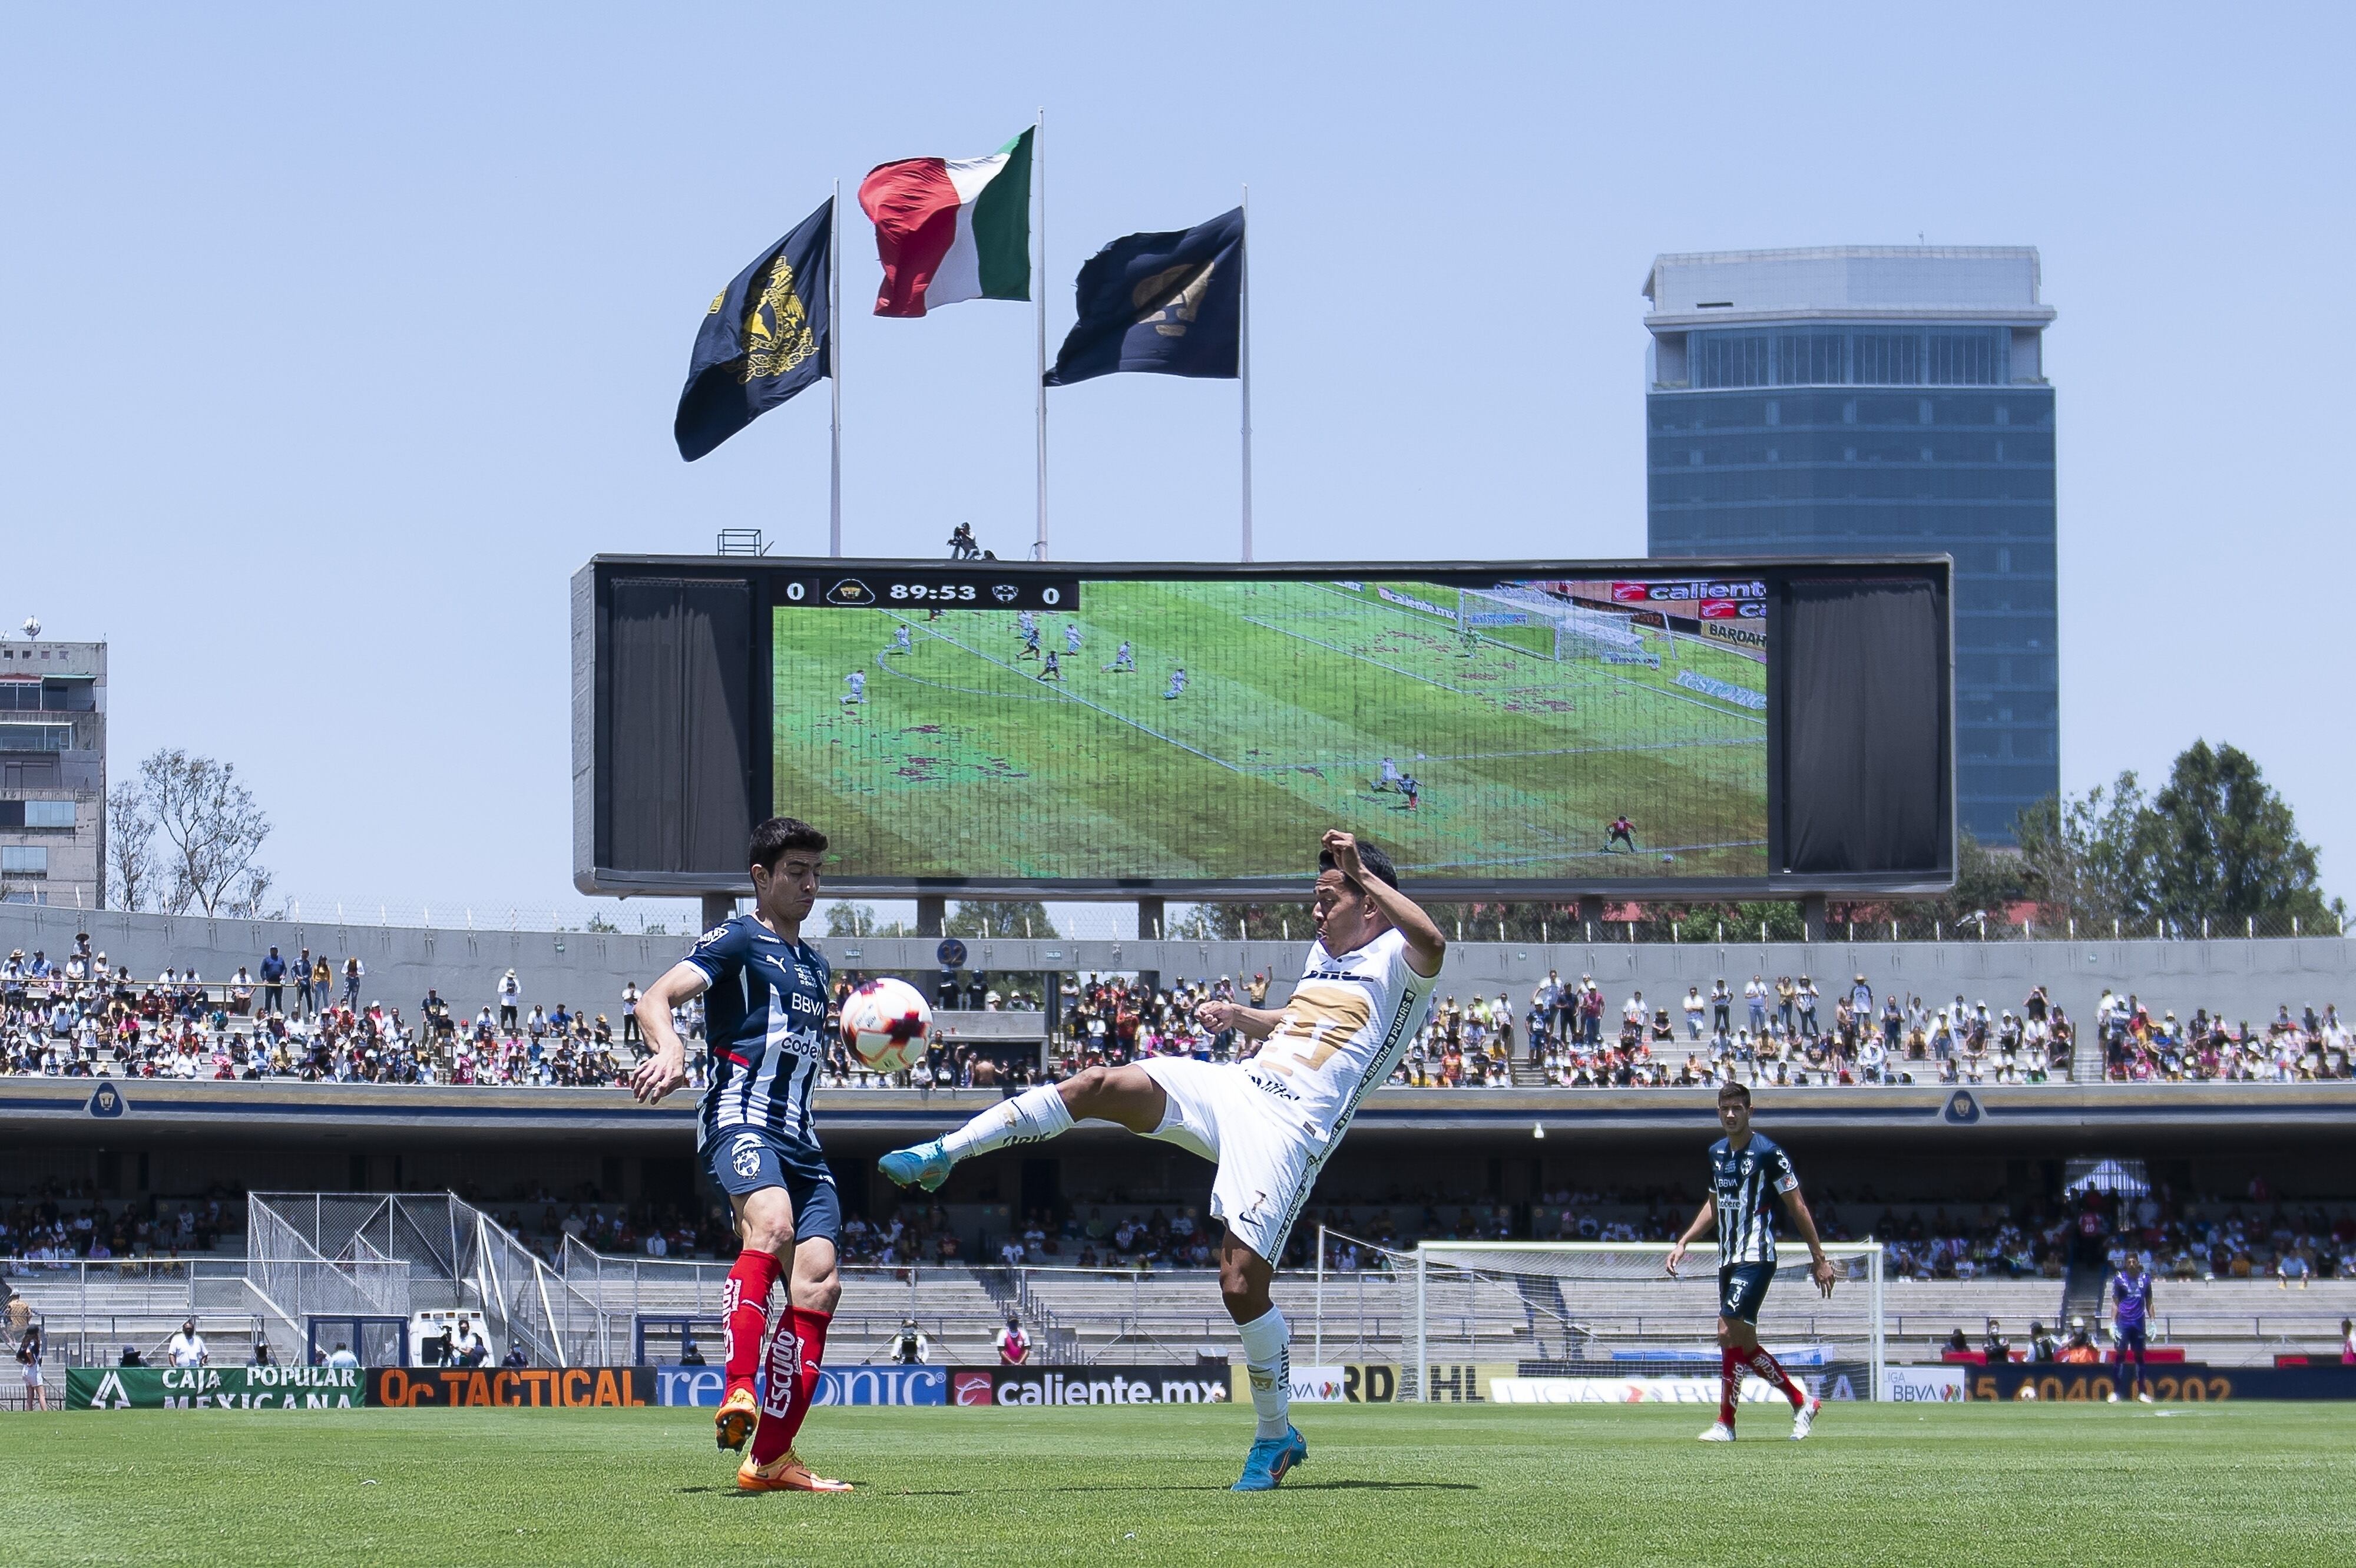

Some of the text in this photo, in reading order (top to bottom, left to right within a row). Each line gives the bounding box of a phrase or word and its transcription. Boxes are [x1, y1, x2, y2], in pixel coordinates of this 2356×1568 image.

[787, 583, 805, 600] 0
[890, 584, 977, 600] 89:53
[1042, 588, 1060, 604] 0
[1650, 581, 1766, 600] calient
[942, 945, 963, 964] 32
[1391, 1001, 1411, 1037] PUMAS
[1366, 1044, 1391, 1079] PUMAS
[1718, 1179, 1738, 1187] BBVA
[162, 1367, 357, 1394] CAJA POPULAR
[440, 1369, 645, 1407] TACTICAL
[997, 1372, 1225, 1405] caliente.mx
[164, 1394, 352, 1409] MEXICANA
[1894, 1384, 1937, 1402] BBVA
